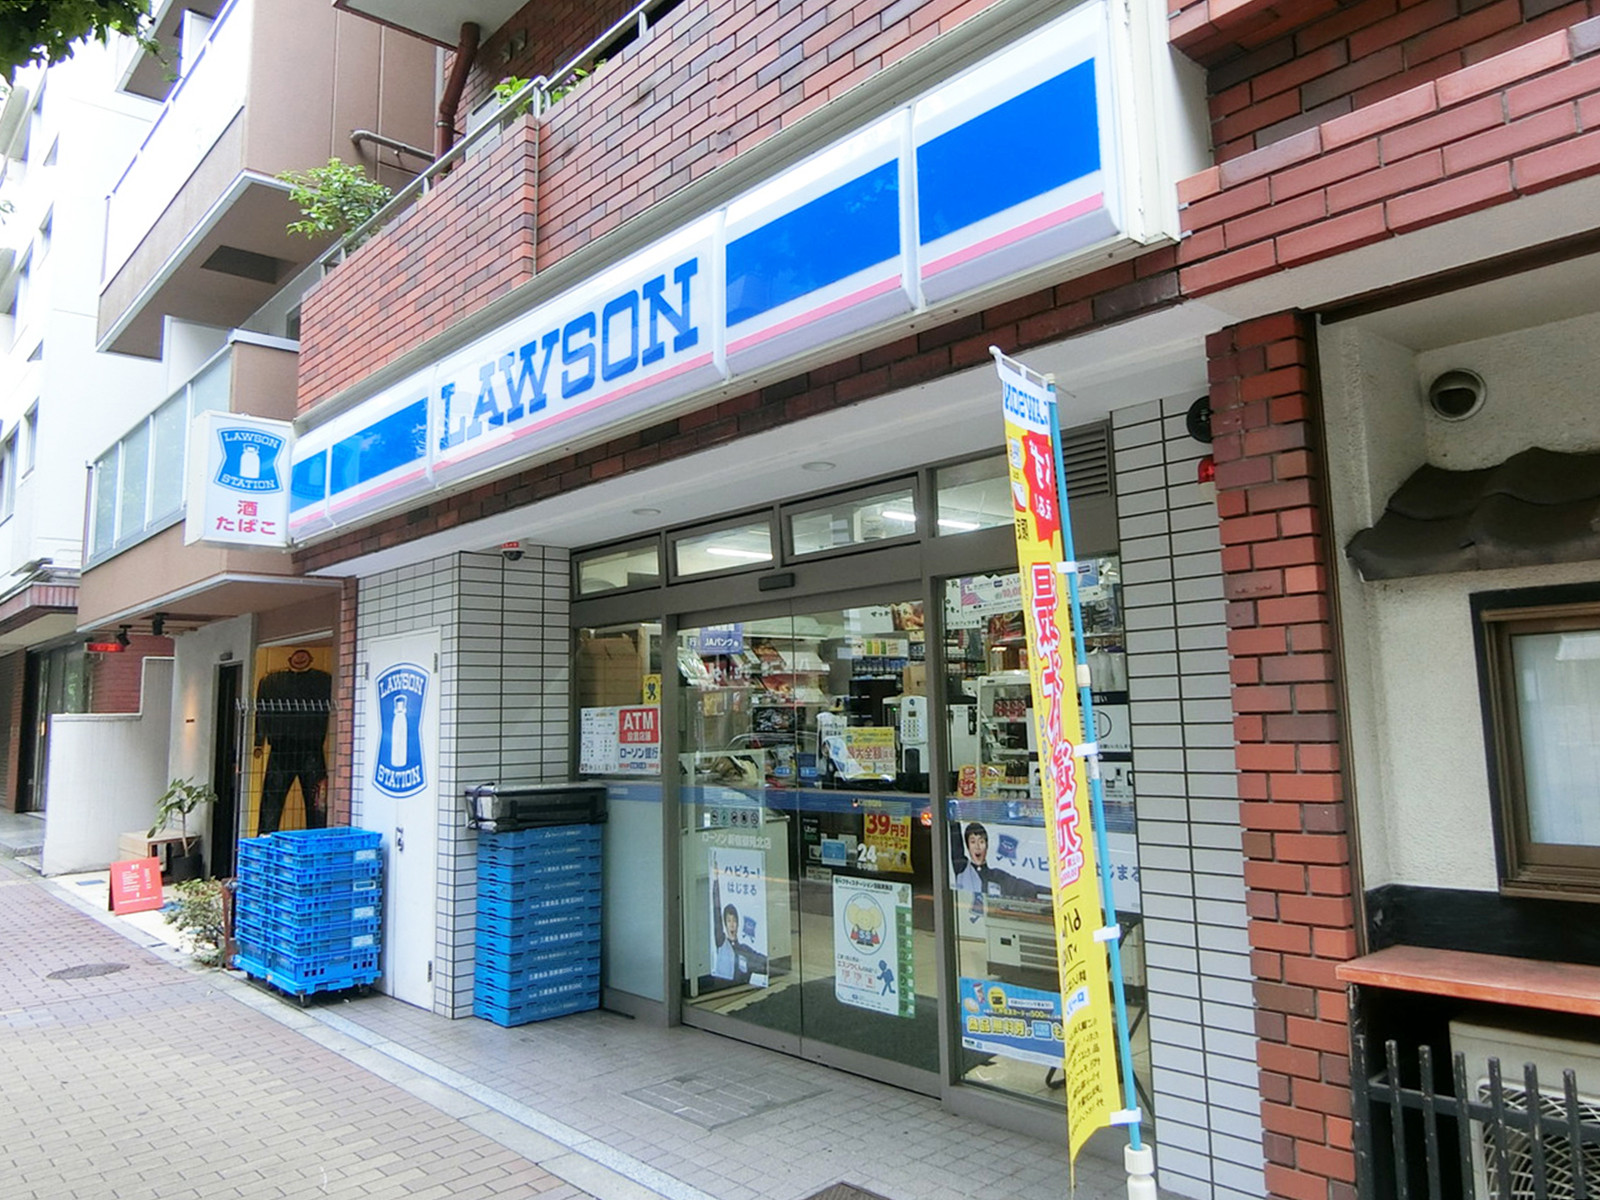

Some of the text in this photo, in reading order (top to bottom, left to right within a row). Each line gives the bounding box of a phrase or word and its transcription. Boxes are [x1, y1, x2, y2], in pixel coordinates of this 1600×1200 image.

[439, 257, 699, 451] LAWSON
[224, 432, 280, 449] LAWSON
[221, 473, 277, 490] STATION
[238, 500, 258, 517] 酒
[215, 516, 277, 536] たばこ
[379, 673, 424, 699] LAWSON
[623, 711, 654, 731] ATM
[619, 747, 659, 760] ローソン銀行
[376, 765, 421, 789] STATION
[857, 843, 878, 863] 24
[727, 881, 758, 896] はじまる
